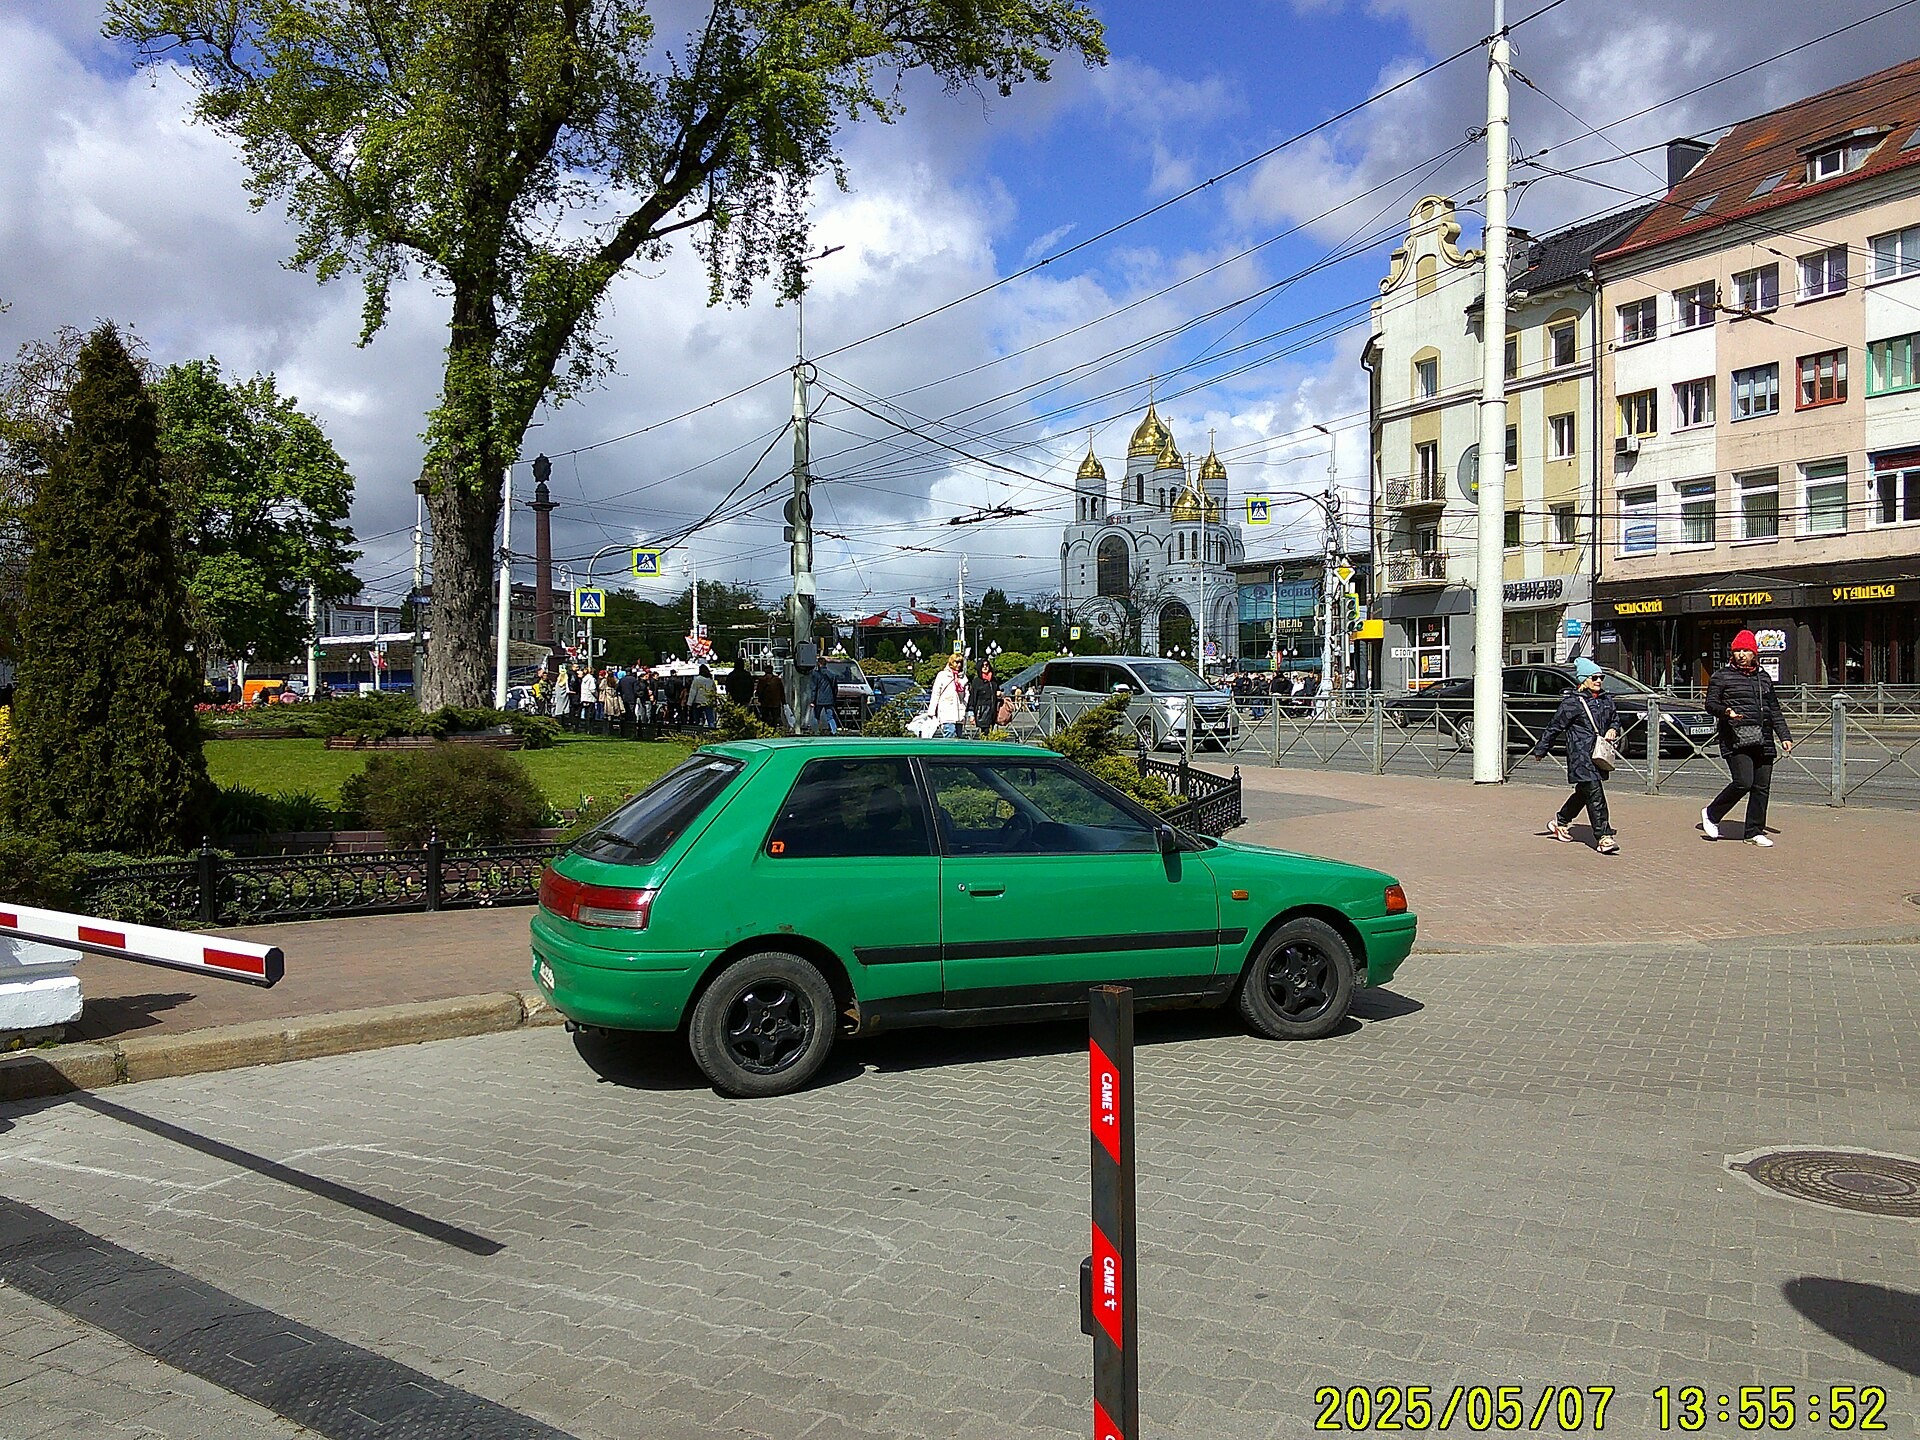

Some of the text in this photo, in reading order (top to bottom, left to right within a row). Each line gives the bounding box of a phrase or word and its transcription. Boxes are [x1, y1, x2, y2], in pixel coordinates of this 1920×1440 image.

[1832, 587, 1842, 600] У
[1277, 619, 1303, 629] МЕЛЬ
[1101, 1072, 1113, 1110] CAME
[1103, 1256, 1115, 1295] CAME
